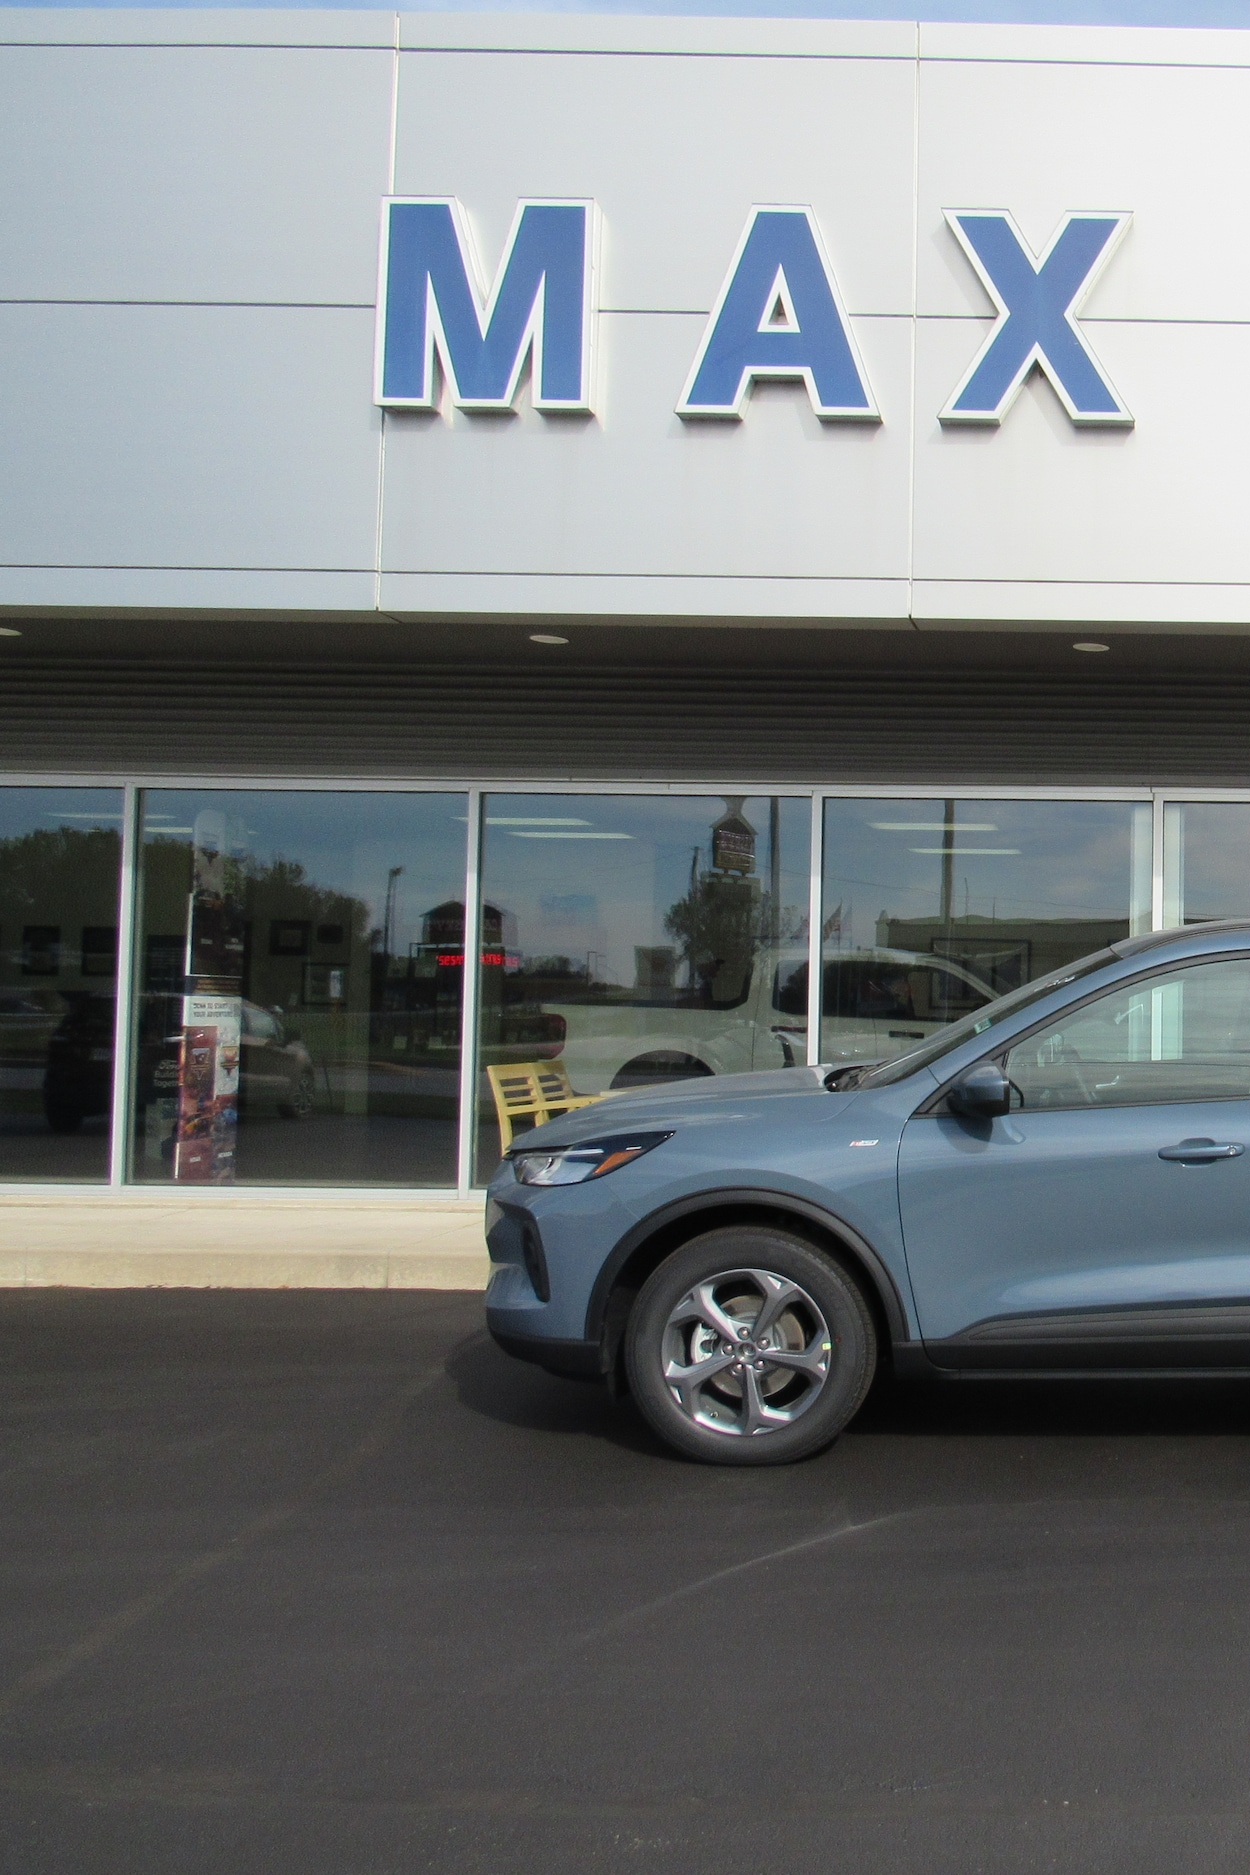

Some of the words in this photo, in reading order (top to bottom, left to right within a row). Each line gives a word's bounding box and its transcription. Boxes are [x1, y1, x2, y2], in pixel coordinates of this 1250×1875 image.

[374, 195, 1136, 426] MAX
[154, 1070, 178, 1078] Buildi
[153, 1079, 178, 1089] Togeth
